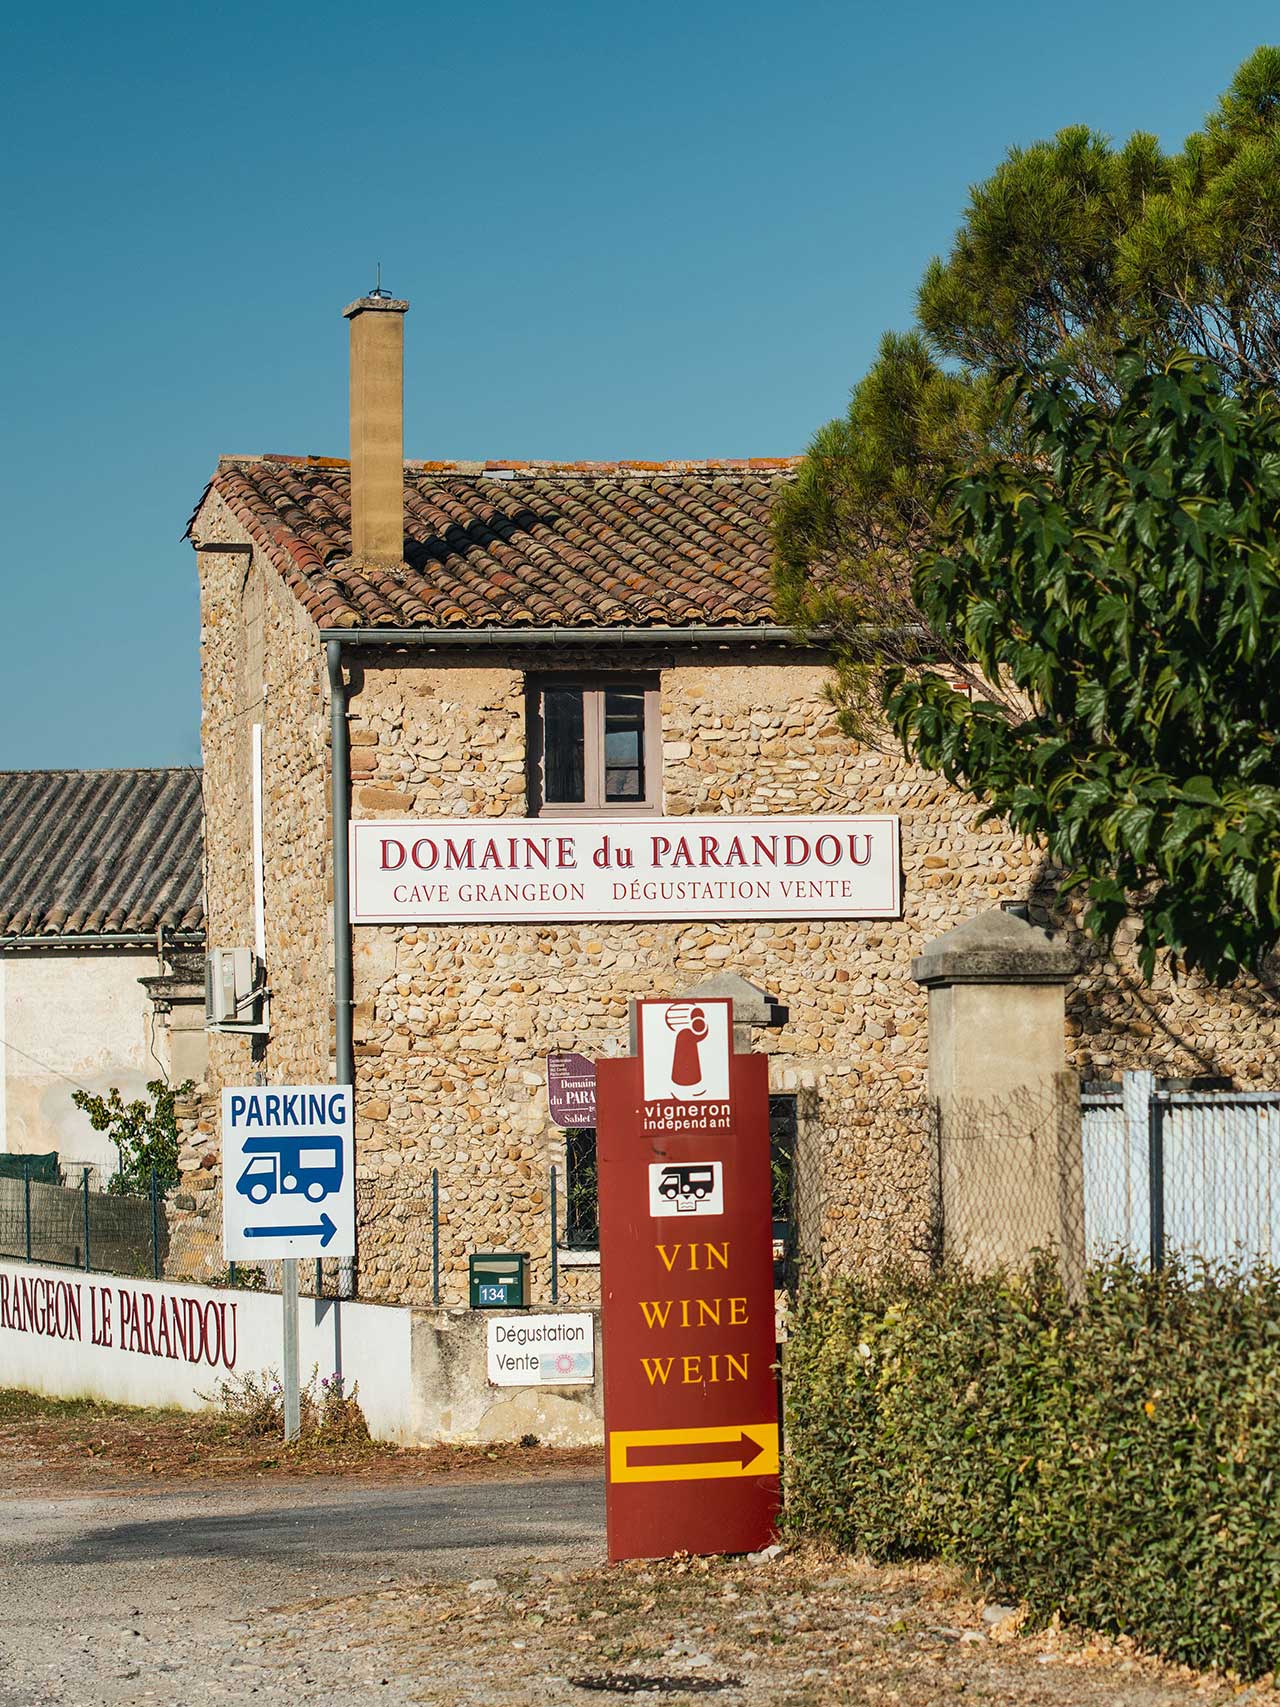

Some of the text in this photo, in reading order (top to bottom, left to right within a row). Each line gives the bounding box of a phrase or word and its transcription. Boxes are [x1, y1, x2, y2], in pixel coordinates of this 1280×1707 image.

[380, 834, 874, 871] DOMAINE du PARANDOU
[393, 879, 853, 902] CAVE GRANGEON DÉGUSTATION VENTE
[231, 1093, 346, 1127] PARKING
[550, 1095, 563, 1105] du
[644, 1103, 731, 1119] vigneron
[564, 1114, 591, 1123] Sablet
[656, 1242, 730, 1272] VIN
[482, 1288, 505, 1300] 134
[639, 1298, 749, 1329] WINE
[89, 1286, 113, 1348] LE
[118, 1289, 238, 1370] PARANDOU
[496, 1325, 585, 1345] Dégustation
[496, 1354, 539, 1370] Vente
[640, 1353, 750, 1385] WEIN
